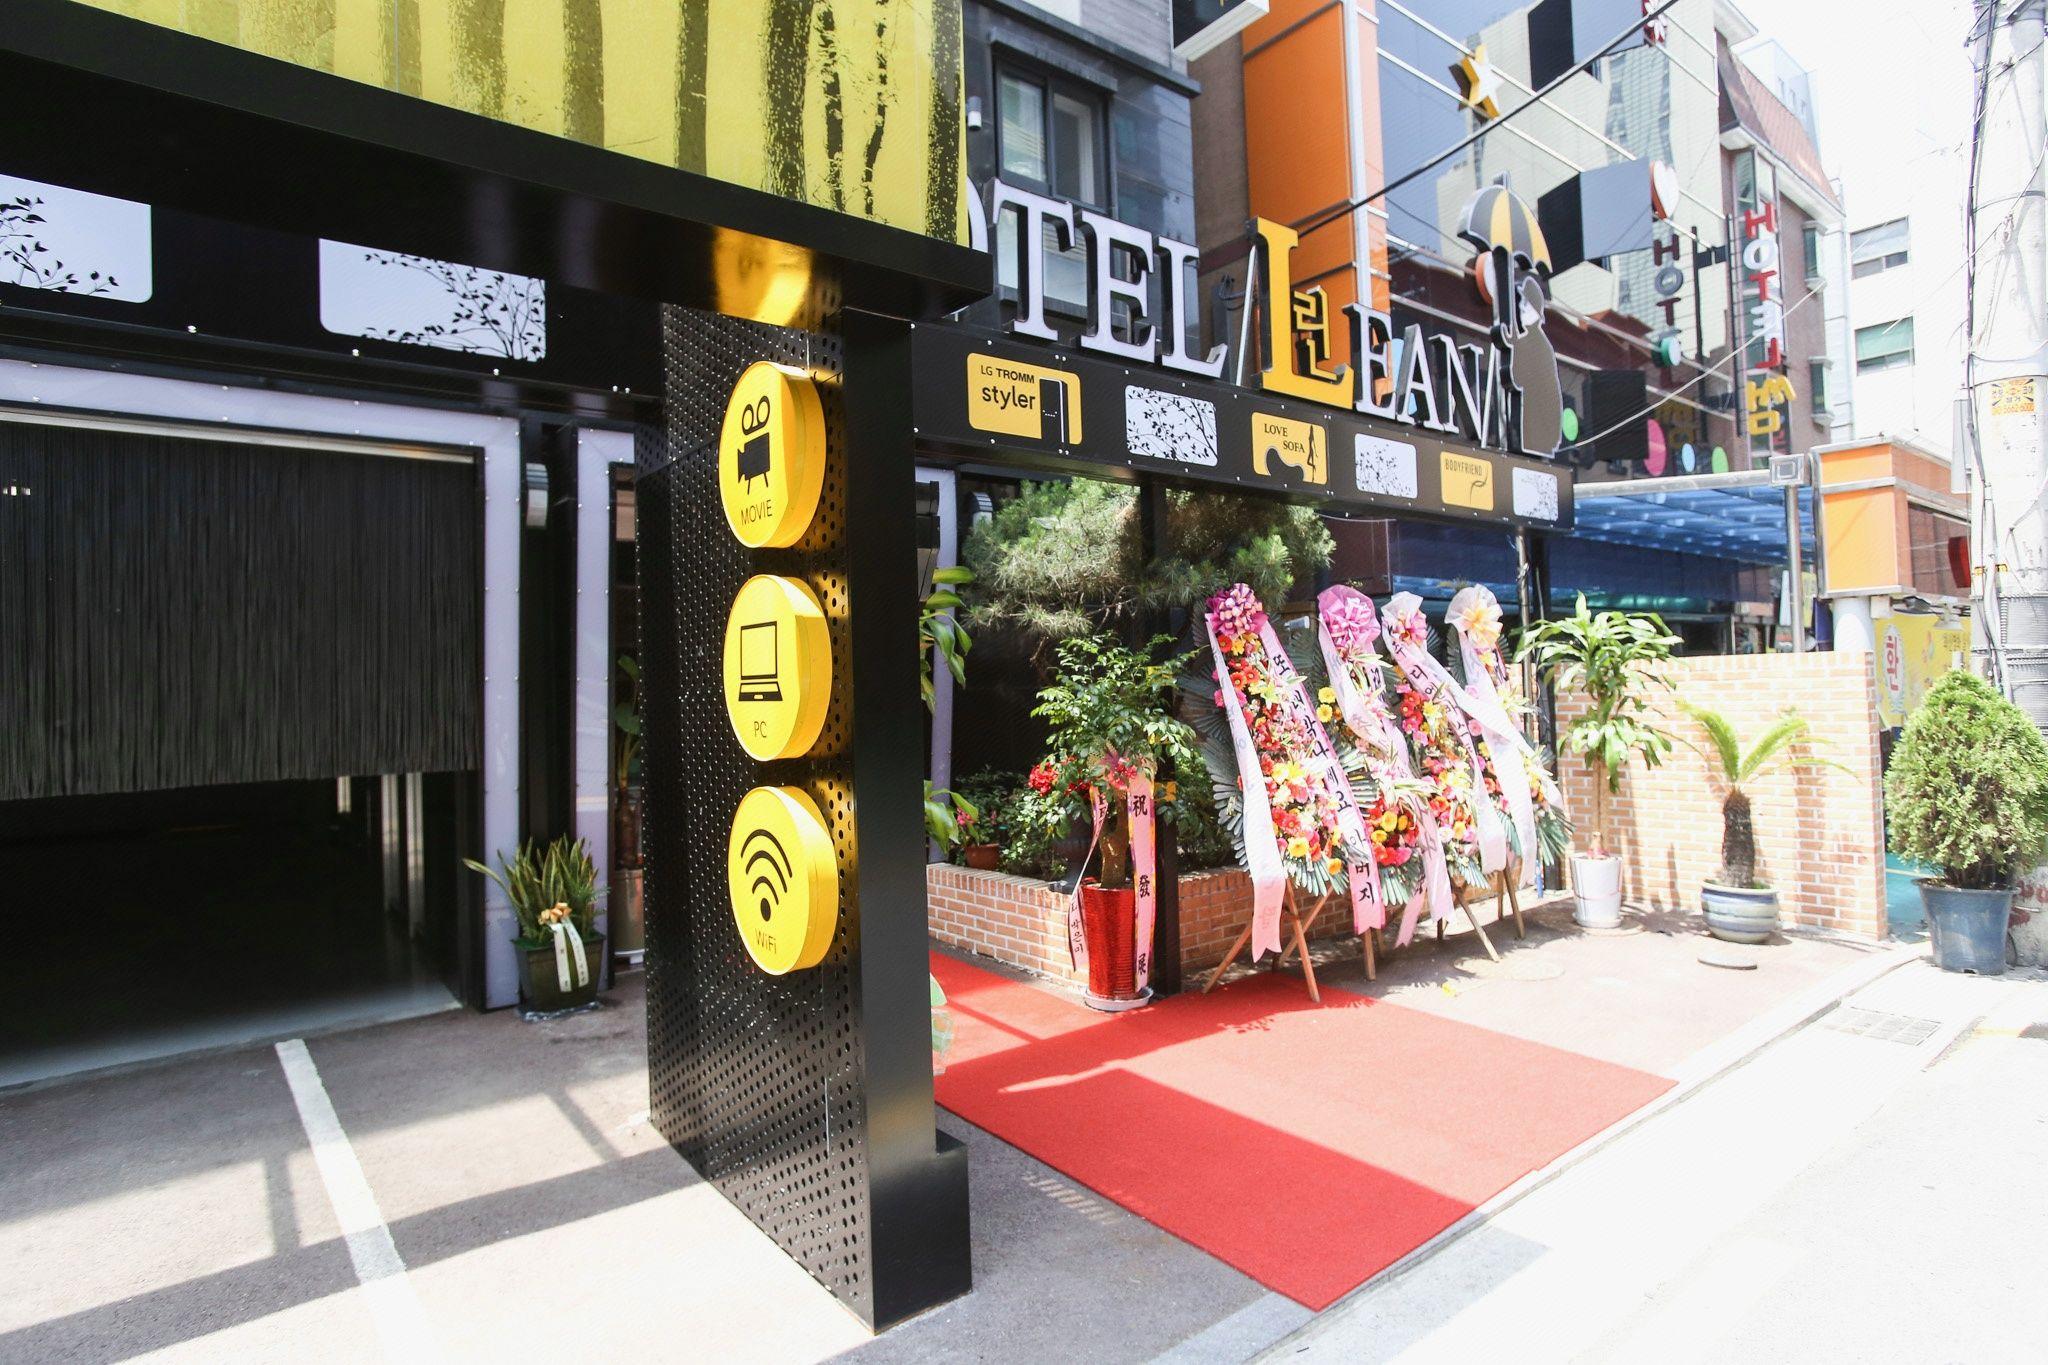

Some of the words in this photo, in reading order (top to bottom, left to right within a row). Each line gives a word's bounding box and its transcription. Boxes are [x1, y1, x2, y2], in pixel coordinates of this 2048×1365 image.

[967, 174, 1229, 378] TEL
[1653, 234, 1688, 389] HOTL
[1293, 287, 1339, 381] 린
[980, 364, 993, 376] LG
[996, 368, 1035, 384] TROMM
[982, 386, 1036, 410] styler
[1264, 423, 1288, 437] LOVE
[1282, 440, 1305, 453] SOFA
[1445, 459, 1483, 476] BODYFRIEND
[740, 499, 773, 526] MOVIE
[753, 720, 767, 738] PC
[1349, 829, 1375, 905] 아버지
[754, 928, 777, 954] WiFi
[1070, 918, 1084, 954] 박은미
